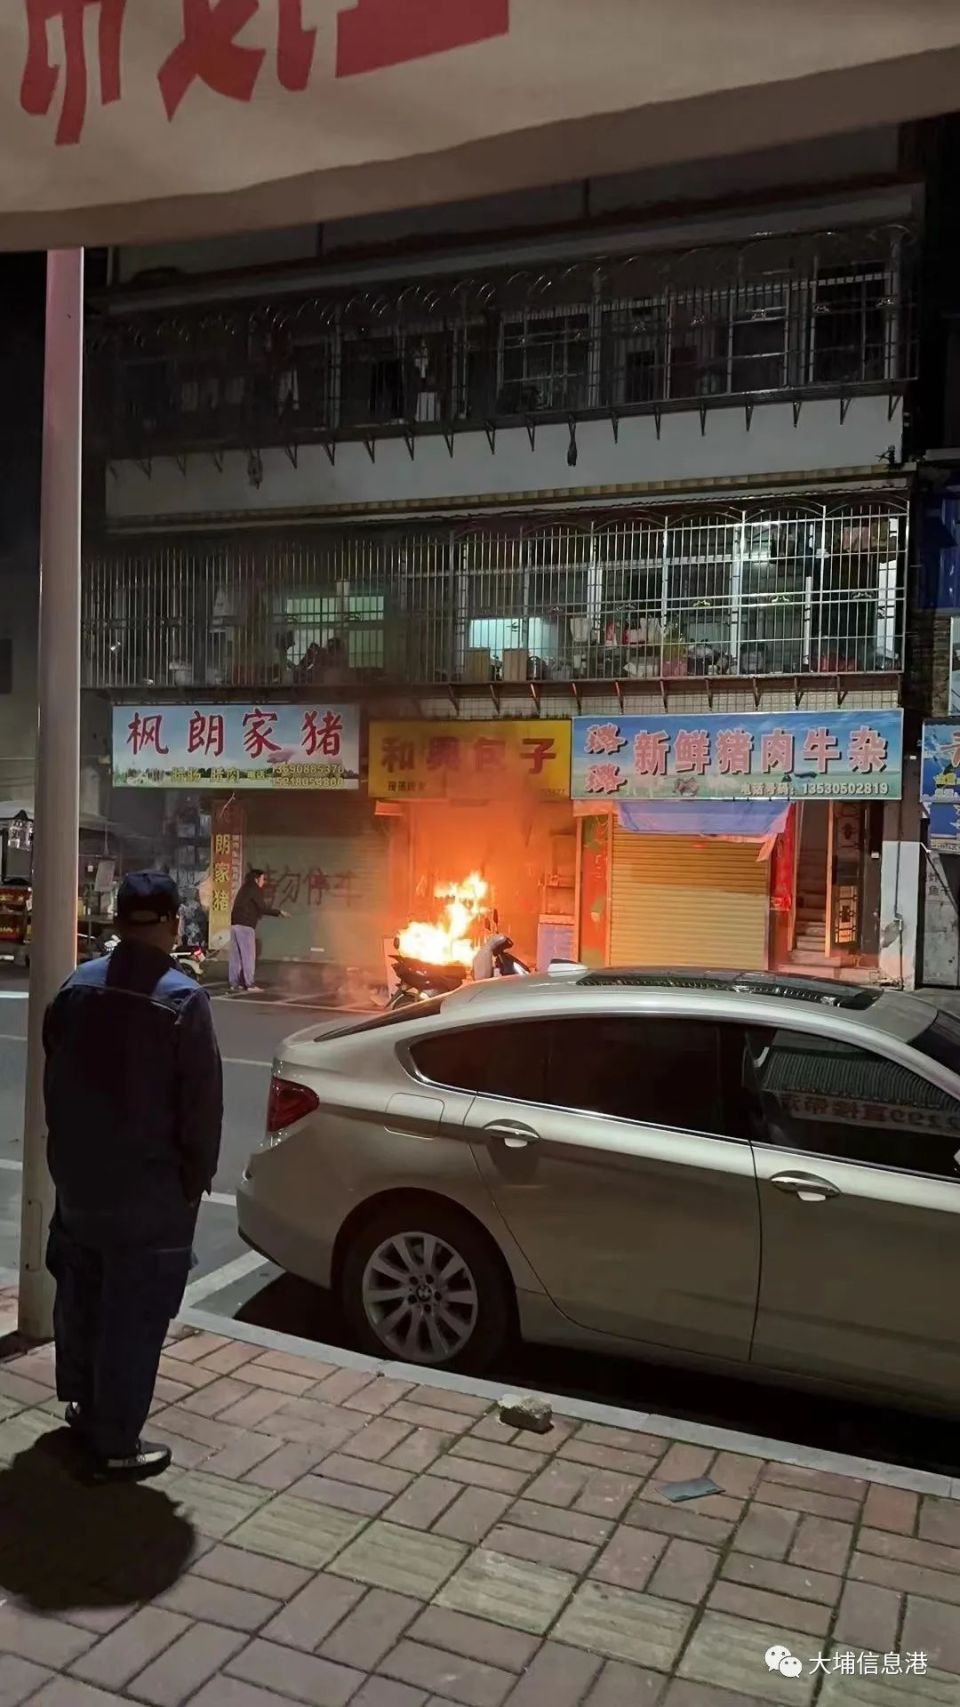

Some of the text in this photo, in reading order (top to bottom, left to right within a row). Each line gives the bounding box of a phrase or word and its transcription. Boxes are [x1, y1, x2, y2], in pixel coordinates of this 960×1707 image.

[126, 708, 344, 759] 枫朗家猪
[634, 725, 889, 775] 新鲜猪肉牛杂
[803, 782, 889, 795] 13530502819
